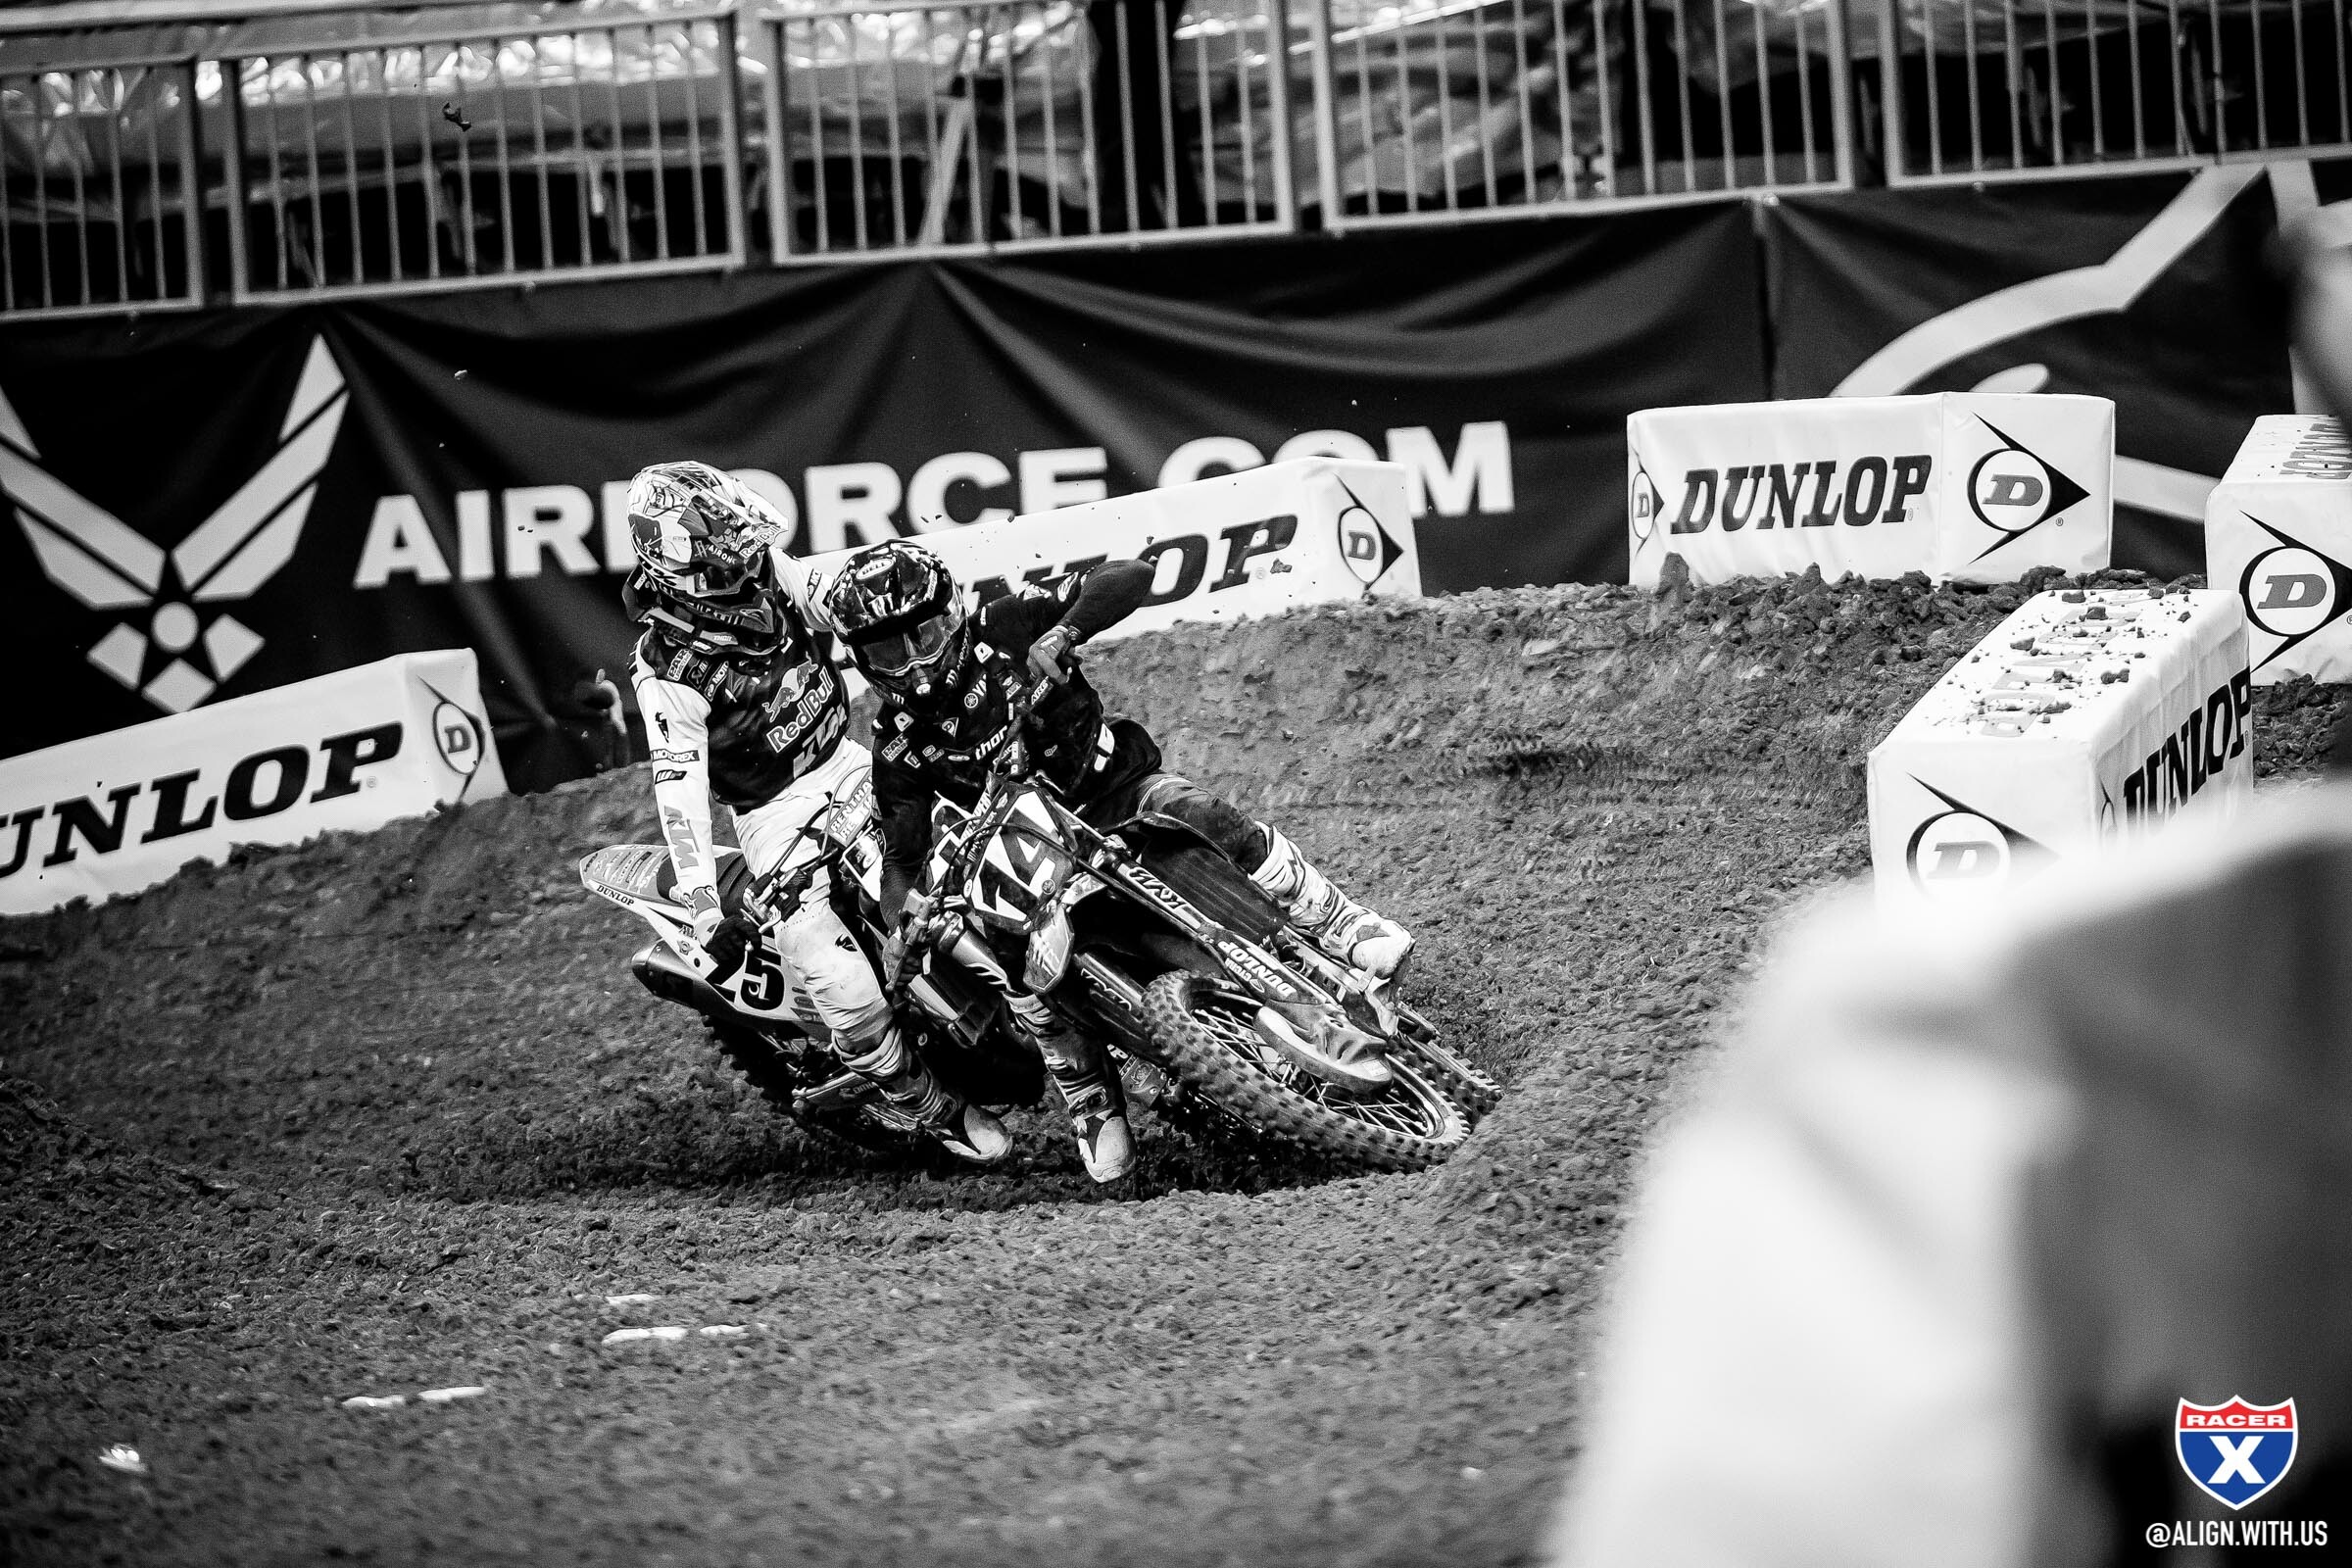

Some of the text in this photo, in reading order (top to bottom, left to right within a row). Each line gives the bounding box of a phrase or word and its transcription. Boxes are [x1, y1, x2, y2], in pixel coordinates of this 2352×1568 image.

[353, 420, 1515, 589] AIRRCEM
[1670, 455, 1933, 535] DUNLOP
[1982, 473, 2044, 507] D
[739, 536, 763, 559] Red
[1347, 530, 1377, 561] D
[2256, 573, 2328, 609] D
[766, 665, 835, 754] Red Bull
[444, 722, 472, 754] D
[975, 725, 1008, 760] thor
[2124, 665, 2252, 825] DUNLOP
[0, 720, 404, 879] UNLOP
[831, 776, 872, 832] RENTHA
[979, 807, 1068, 912] 14
[597, 884, 635, 906] DUNLOP
[1218, 941, 1298, 998] DUNLOP
